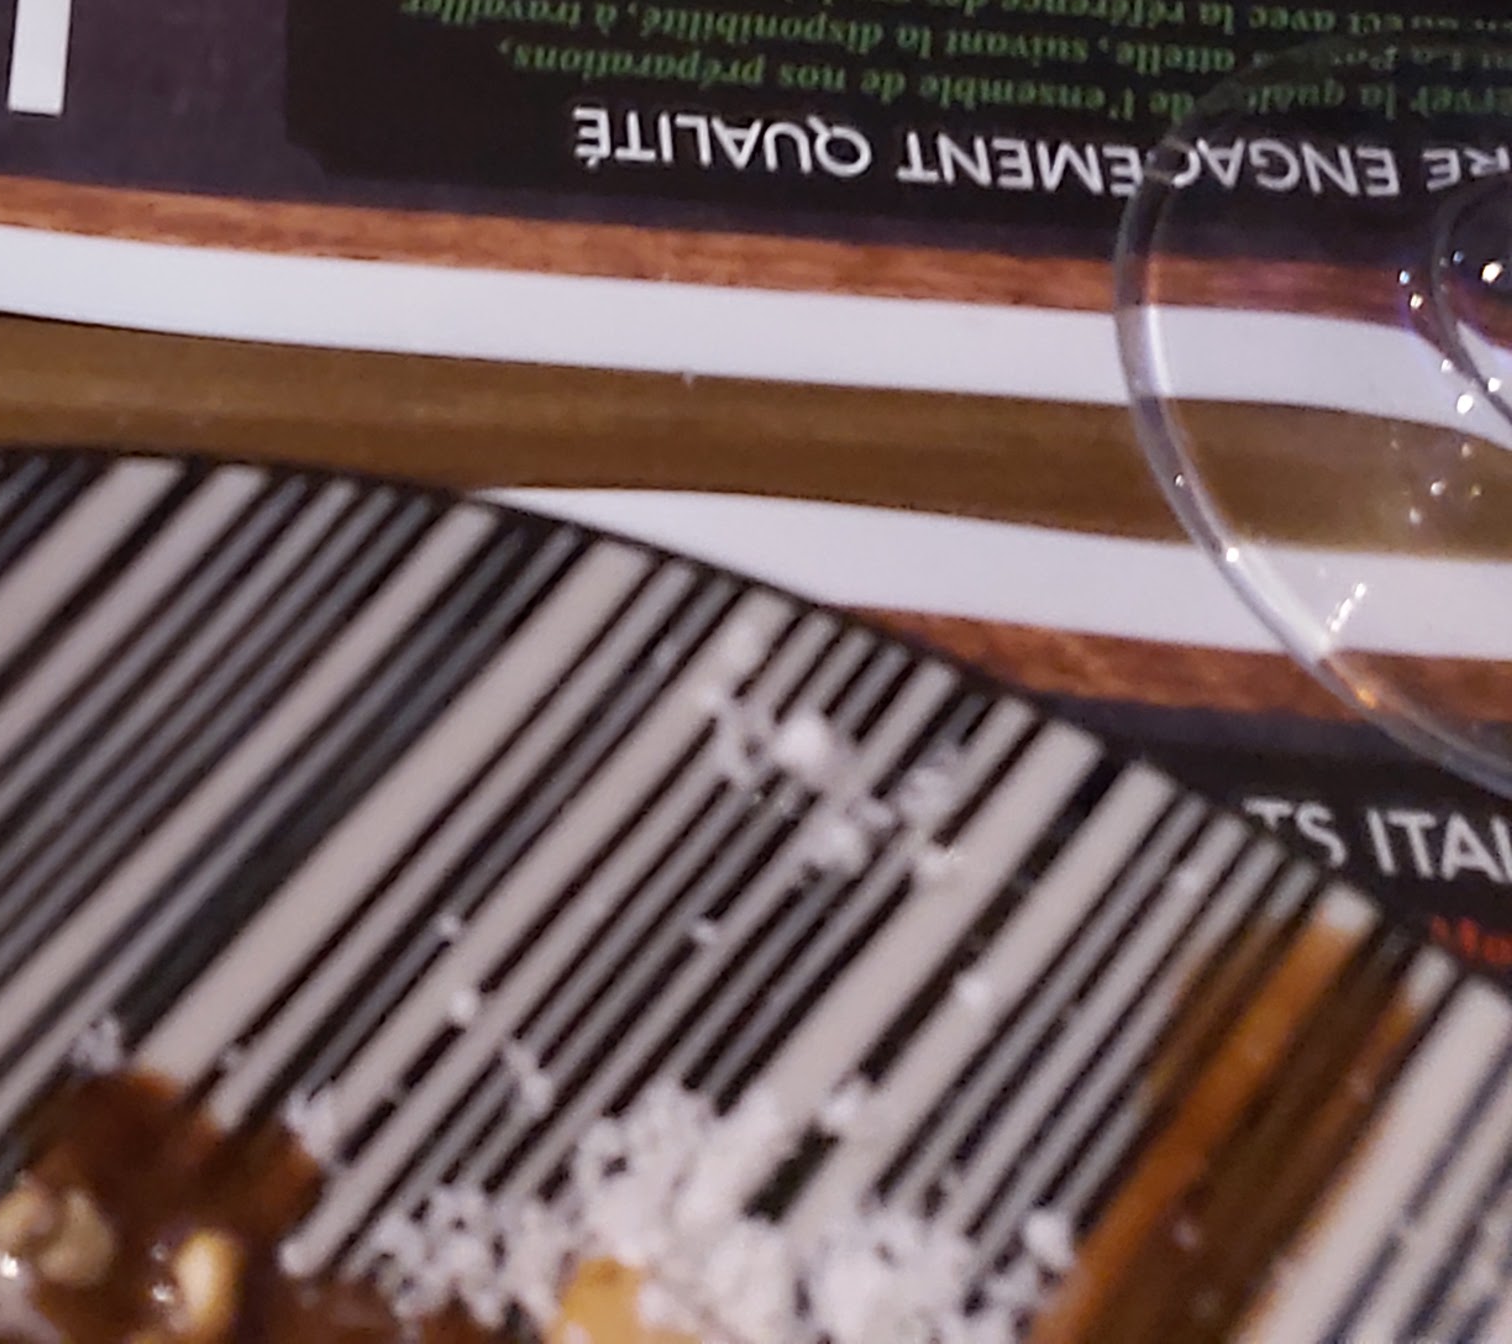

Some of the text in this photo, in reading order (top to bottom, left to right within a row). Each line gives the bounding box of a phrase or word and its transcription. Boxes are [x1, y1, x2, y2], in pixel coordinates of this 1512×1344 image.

[778, 63, 847, 93] nos
[860, 69, 906, 104] de
[571, 106, 872, 178] QUALITÉ
